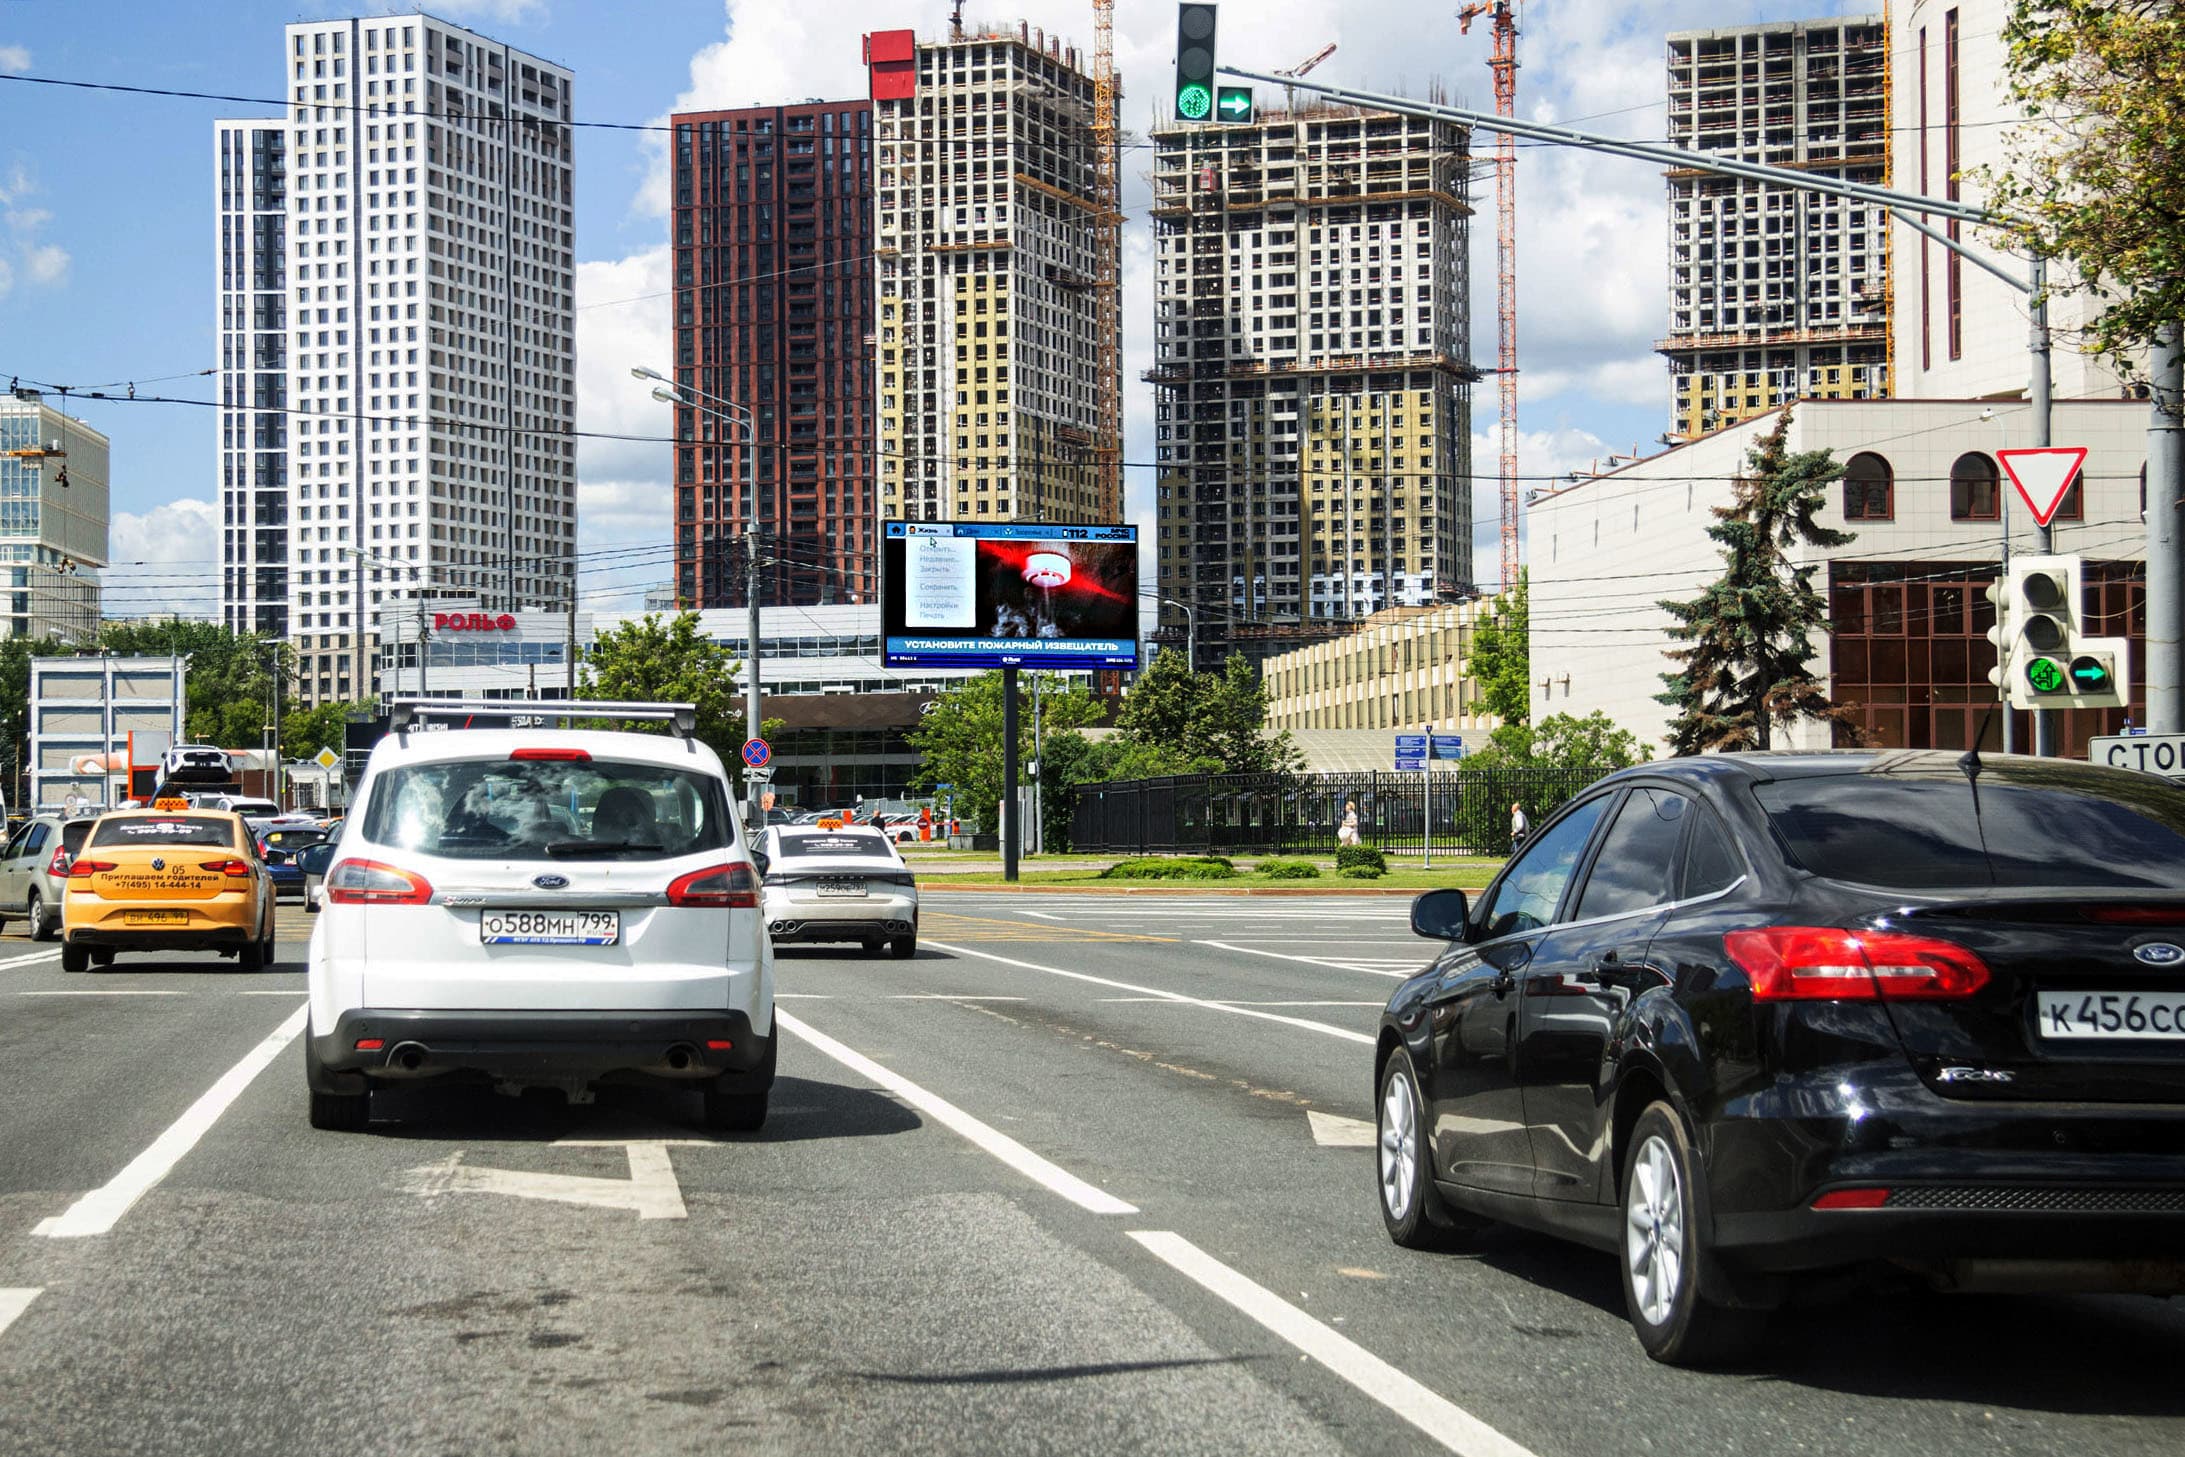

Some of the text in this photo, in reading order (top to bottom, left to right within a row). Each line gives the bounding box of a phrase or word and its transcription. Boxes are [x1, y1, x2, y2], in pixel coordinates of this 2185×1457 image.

[1069, 529, 1088, 539] 112
[434, 612, 517, 632] РОЛЬФ
[904, 640, 1119, 651] УСТАНОВИТЕ ПОЖАРНЫЙ ИЗВЕЩАТЕЛЬ
[2107, 742, 2185, 771] СТО
[172, 865, 186, 875] 05
[101, 873, 164, 882] Приглашаем
[115, 881, 202, 890] +7(495) 14-444-14
[489, 913, 612, 935] О588МН 799
[1935, 1066, 2016, 1082] Focus
